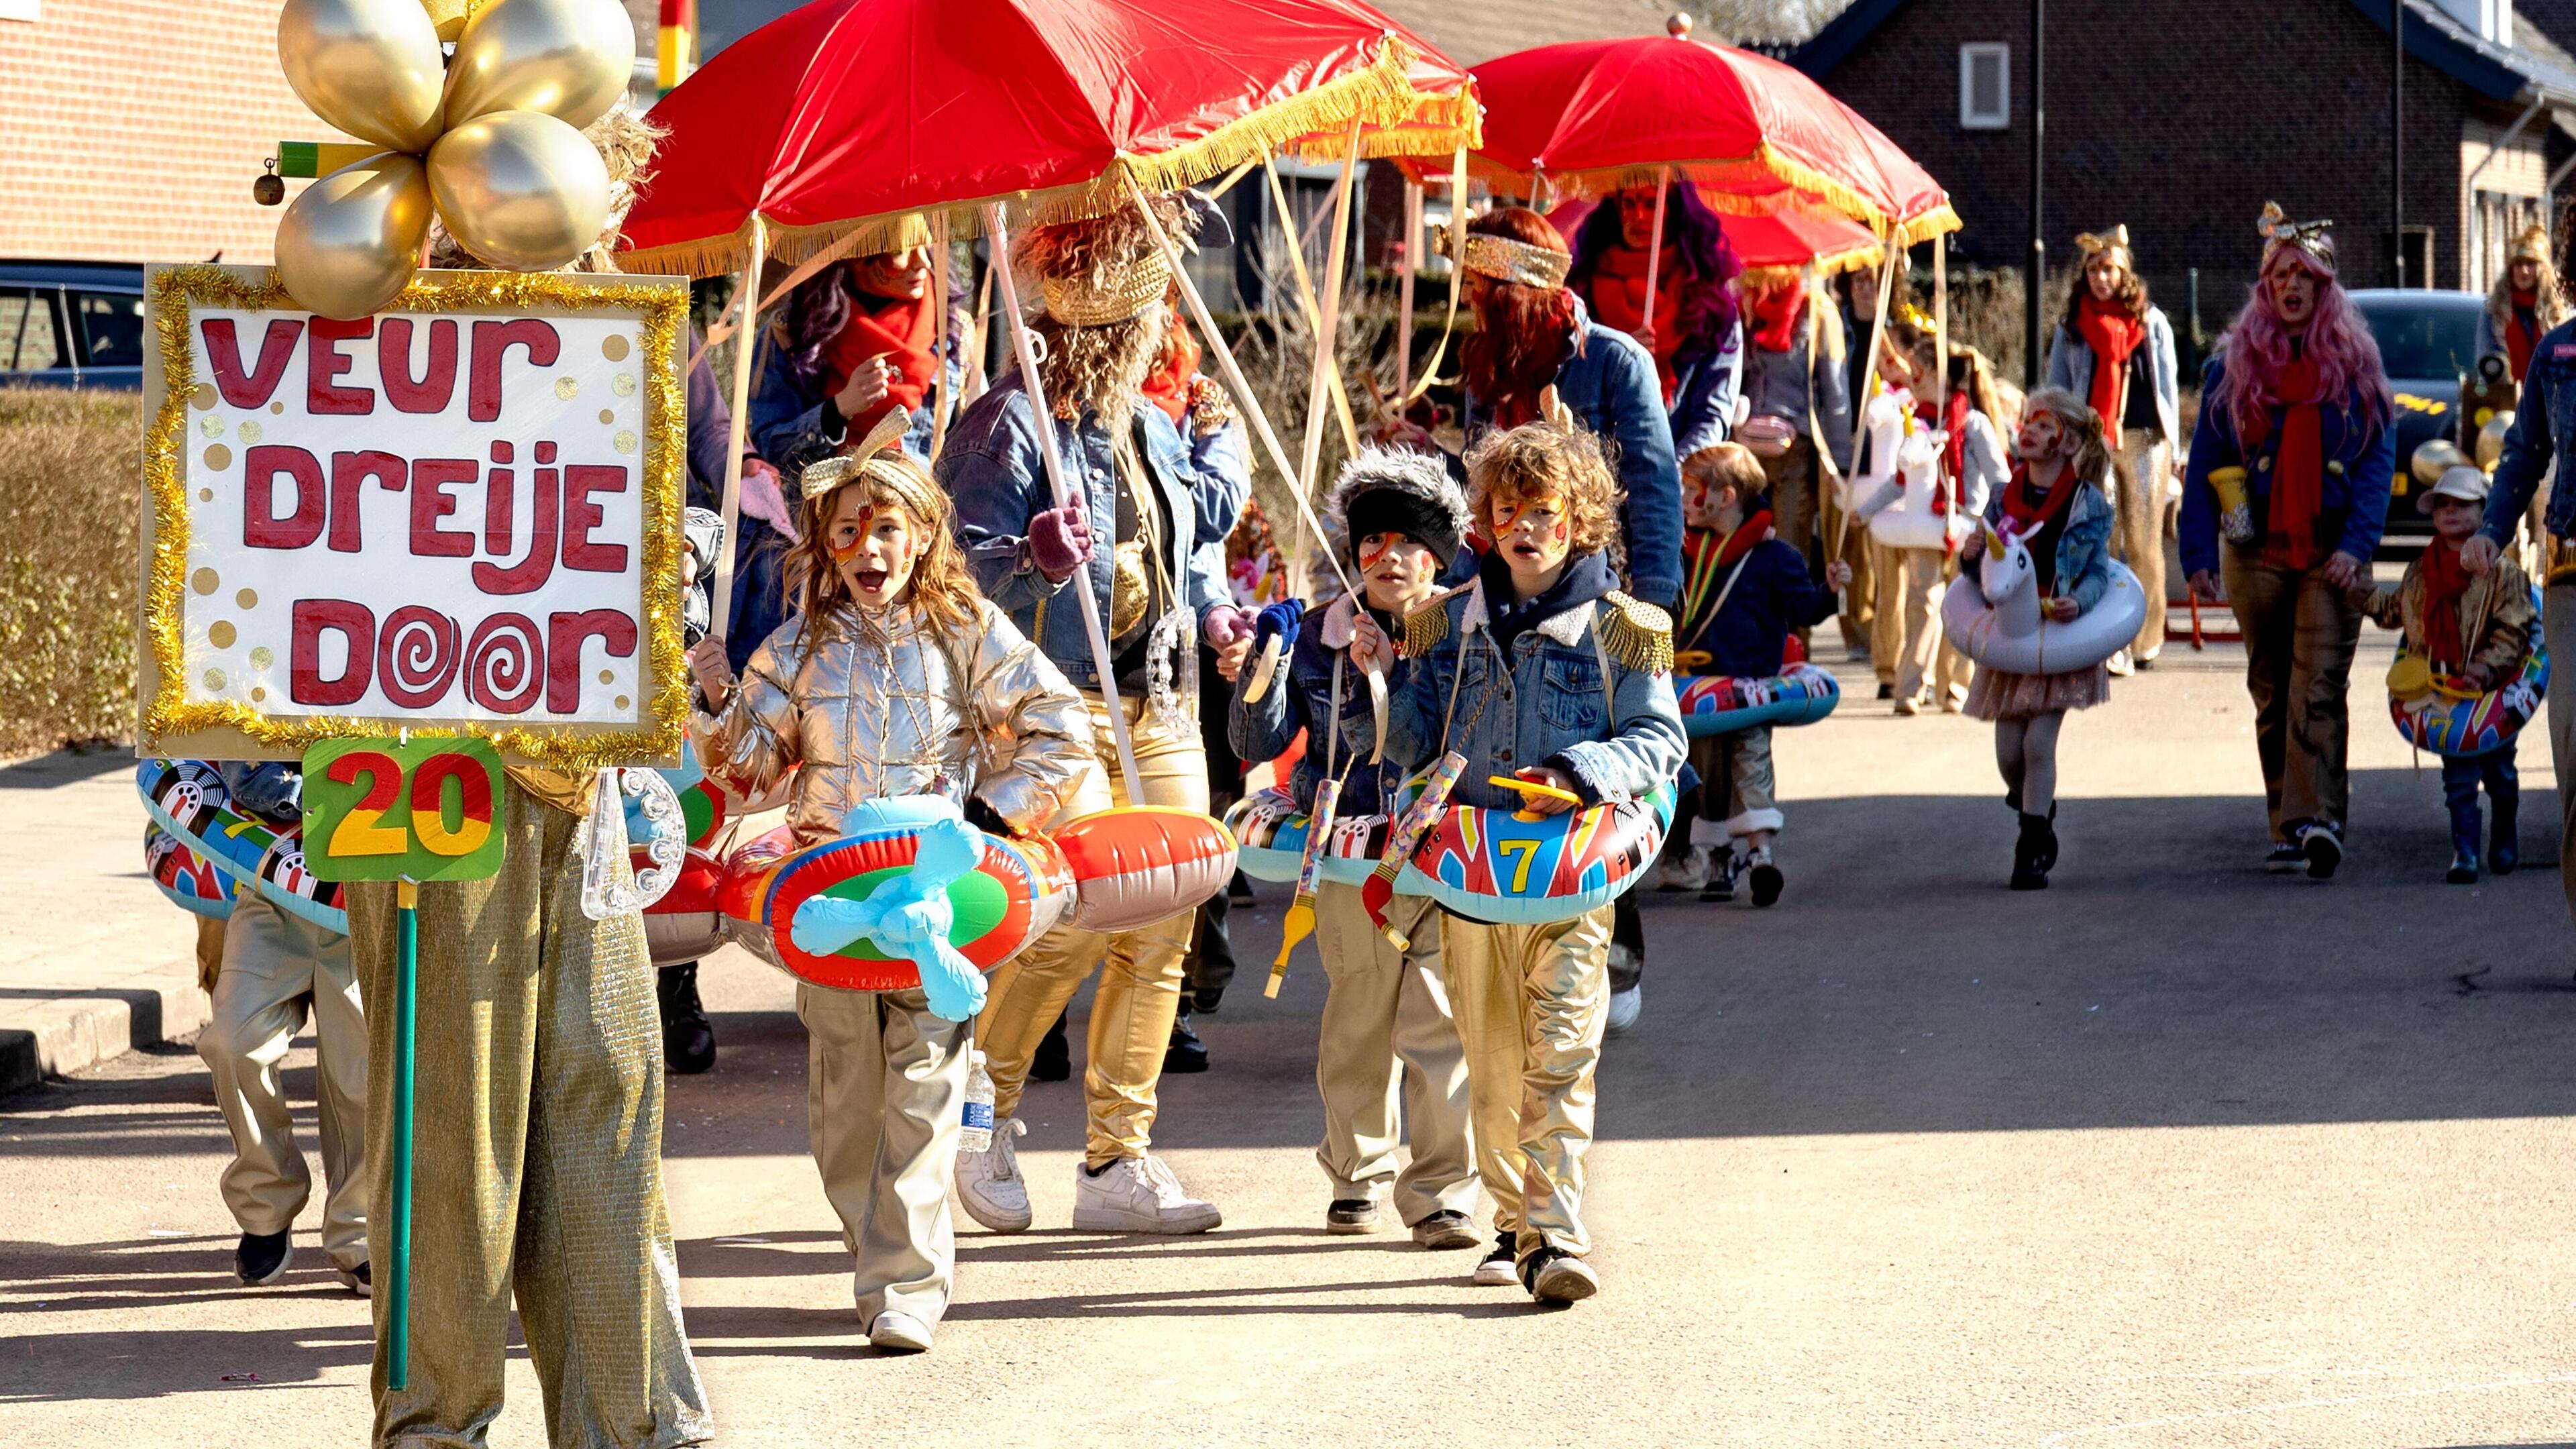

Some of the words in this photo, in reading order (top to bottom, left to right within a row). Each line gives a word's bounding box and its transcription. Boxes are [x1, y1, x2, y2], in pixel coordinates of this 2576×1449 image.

[2430, 718, 2455, 750] 7
[223, 808, 269, 841] 7
[327, 751, 492, 857] 20
[1499, 839, 1542, 893] 7
